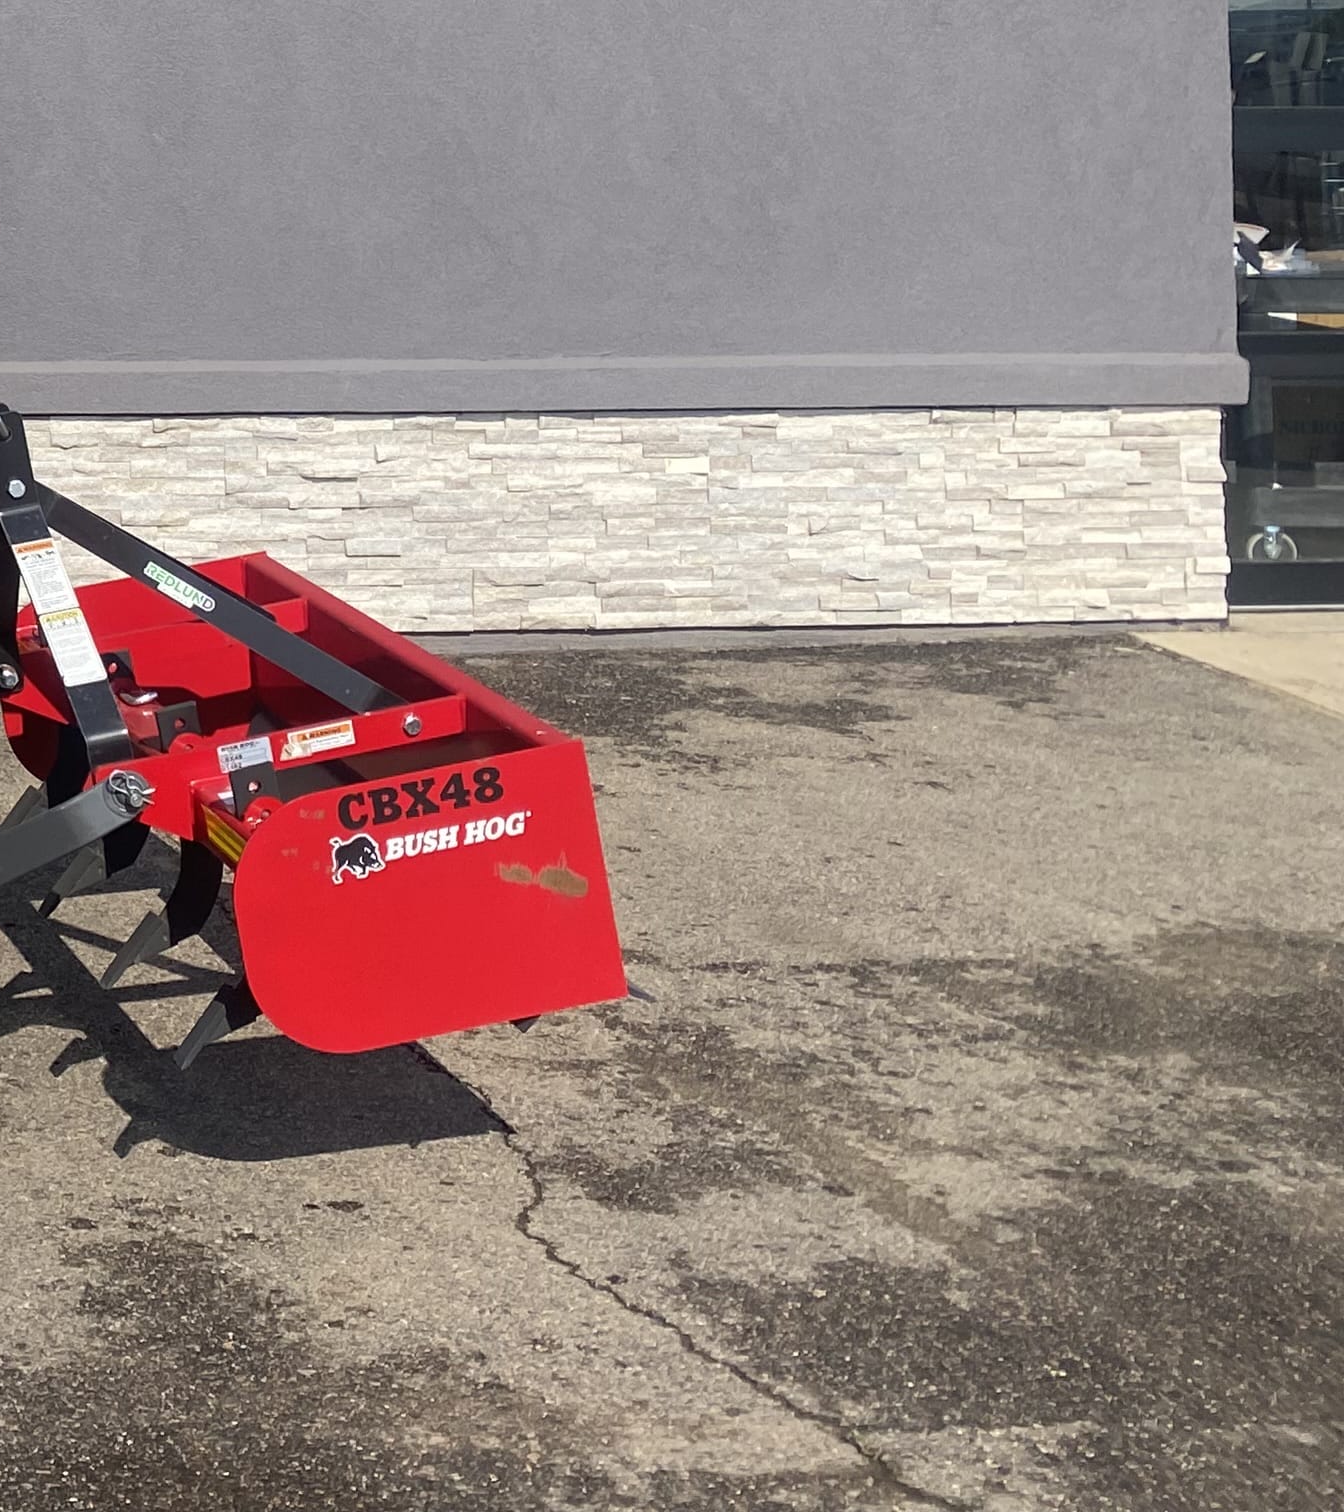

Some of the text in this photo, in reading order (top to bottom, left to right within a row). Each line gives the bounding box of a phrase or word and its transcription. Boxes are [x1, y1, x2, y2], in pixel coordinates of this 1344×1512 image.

[146, 563, 213, 609] REDLUND
[337, 766, 504, 831] CBX48
[384, 810, 527, 862] BUSH HOG
